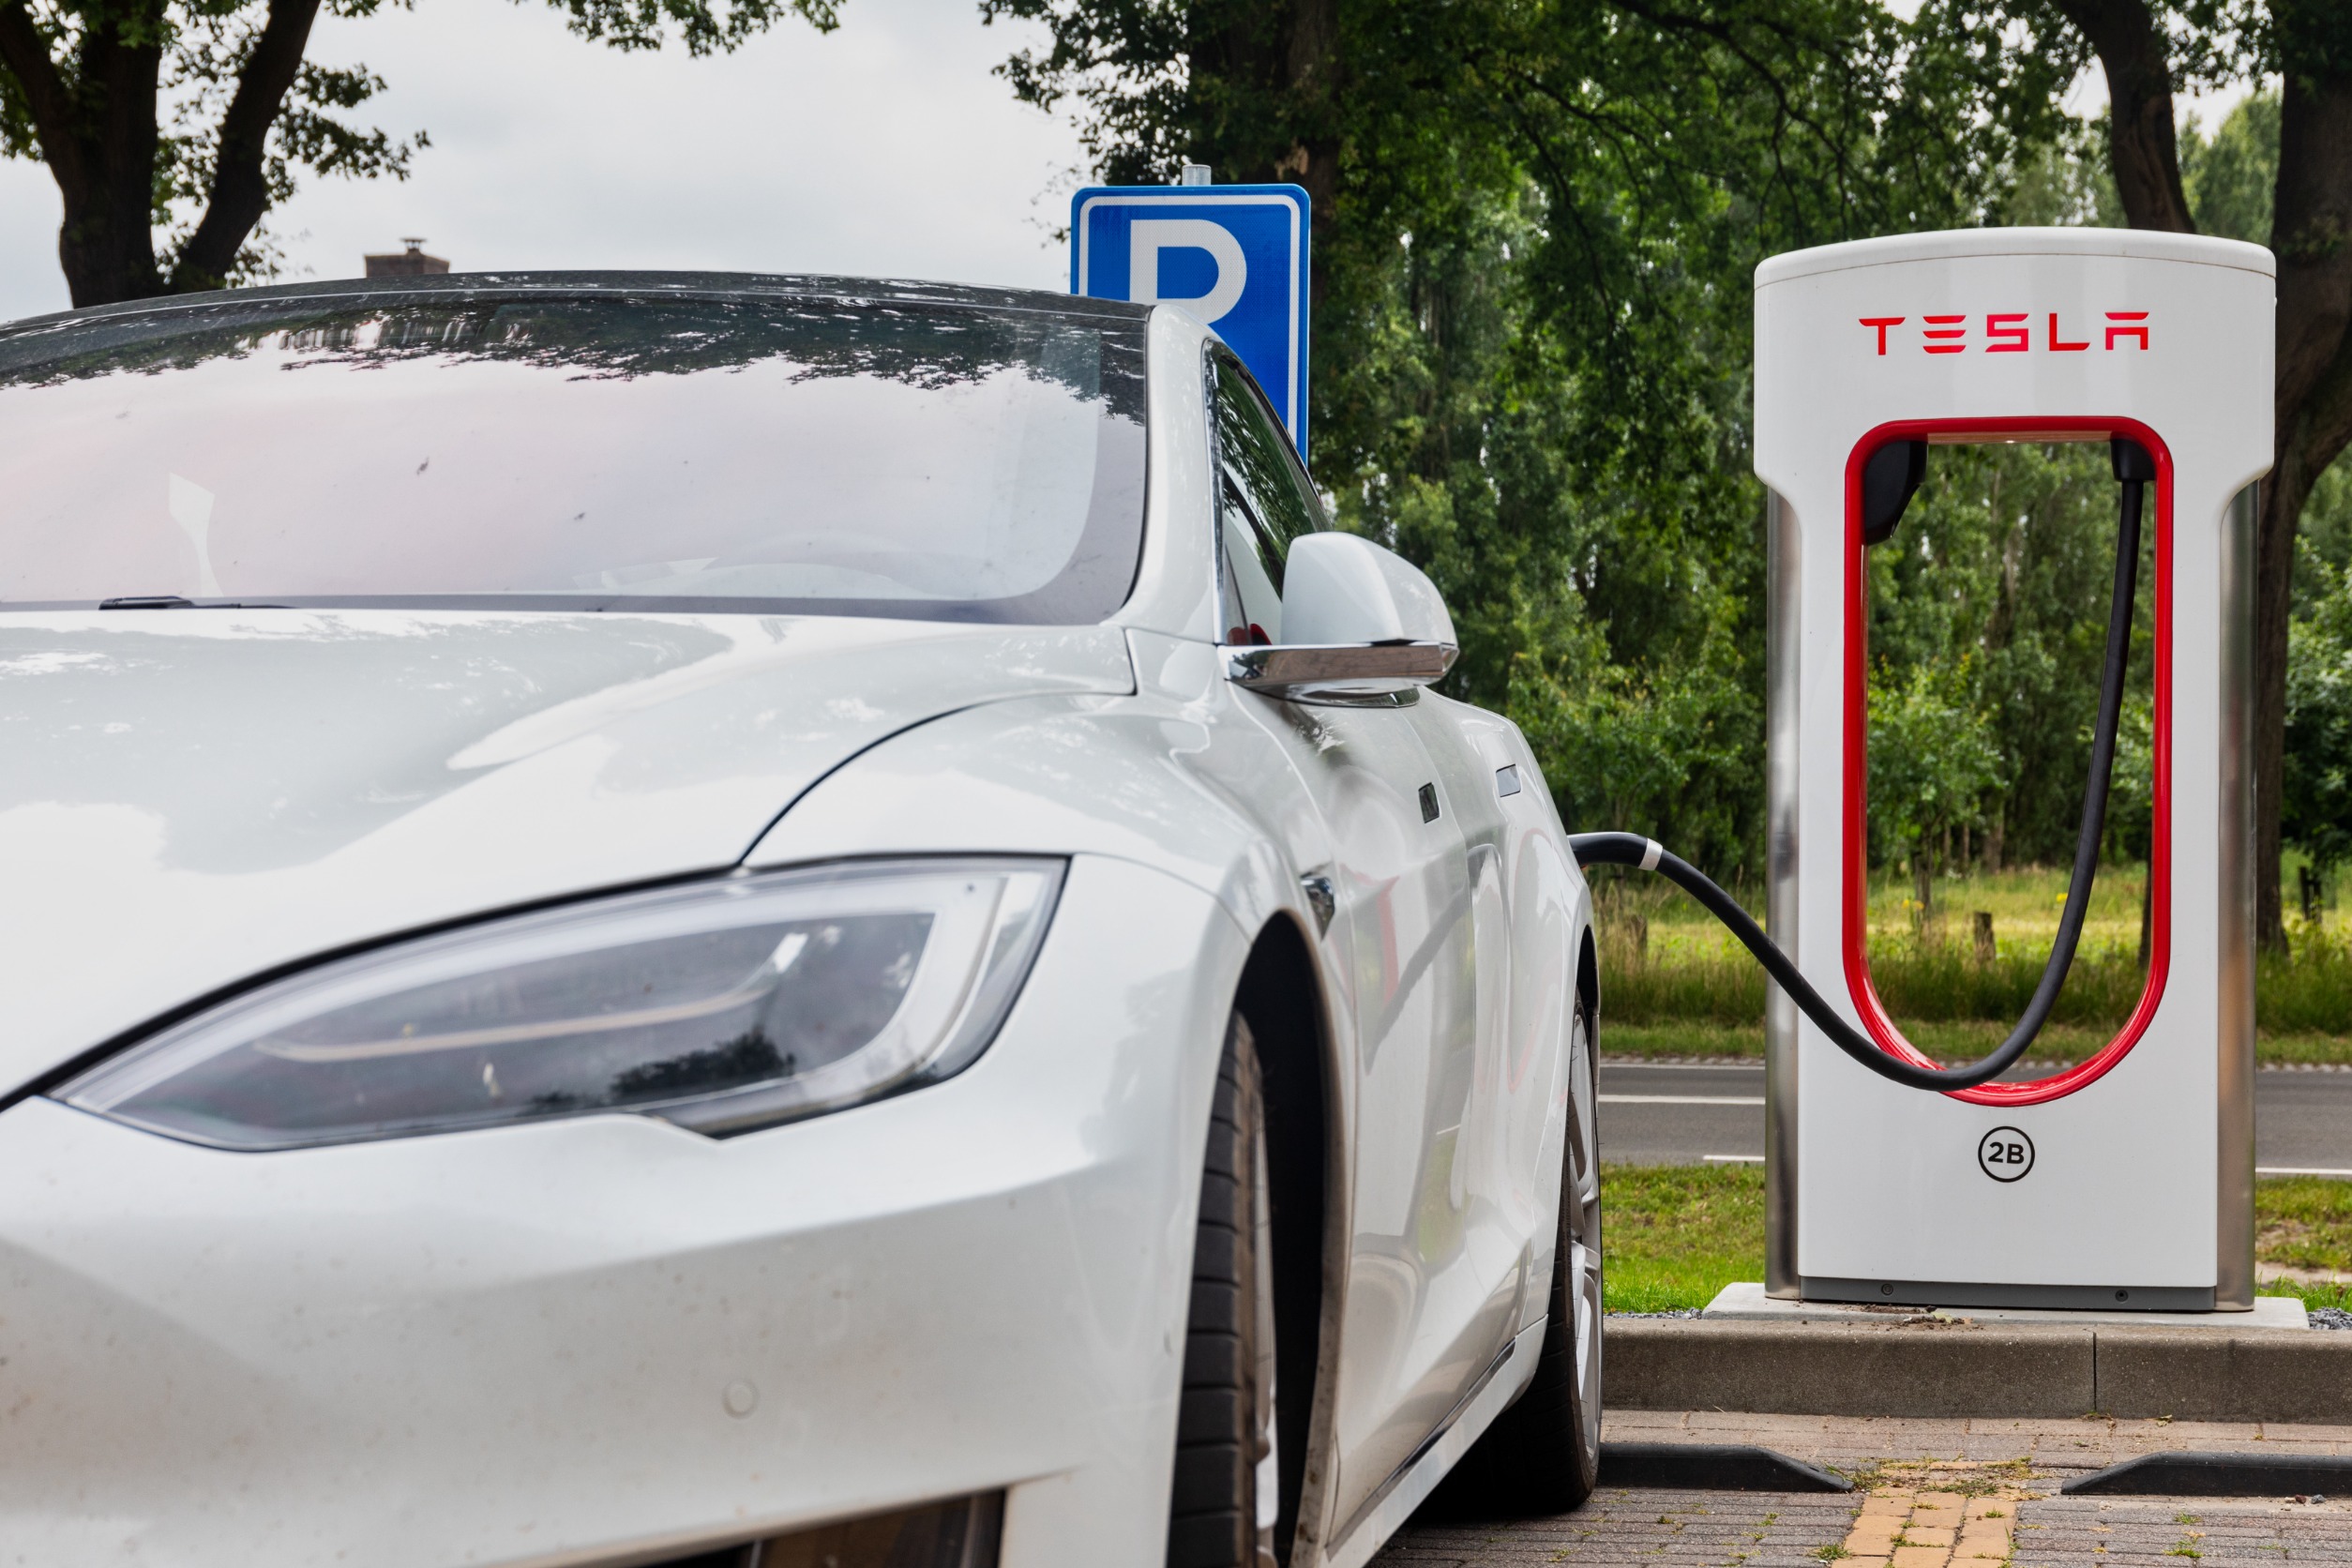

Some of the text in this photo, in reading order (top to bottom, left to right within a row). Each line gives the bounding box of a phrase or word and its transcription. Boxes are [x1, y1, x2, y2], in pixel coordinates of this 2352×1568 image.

[1129, 219, 1247, 325] P
[1859, 310, 2150, 356] TESLA
[1987, 1141, 2025, 1165] 2B
